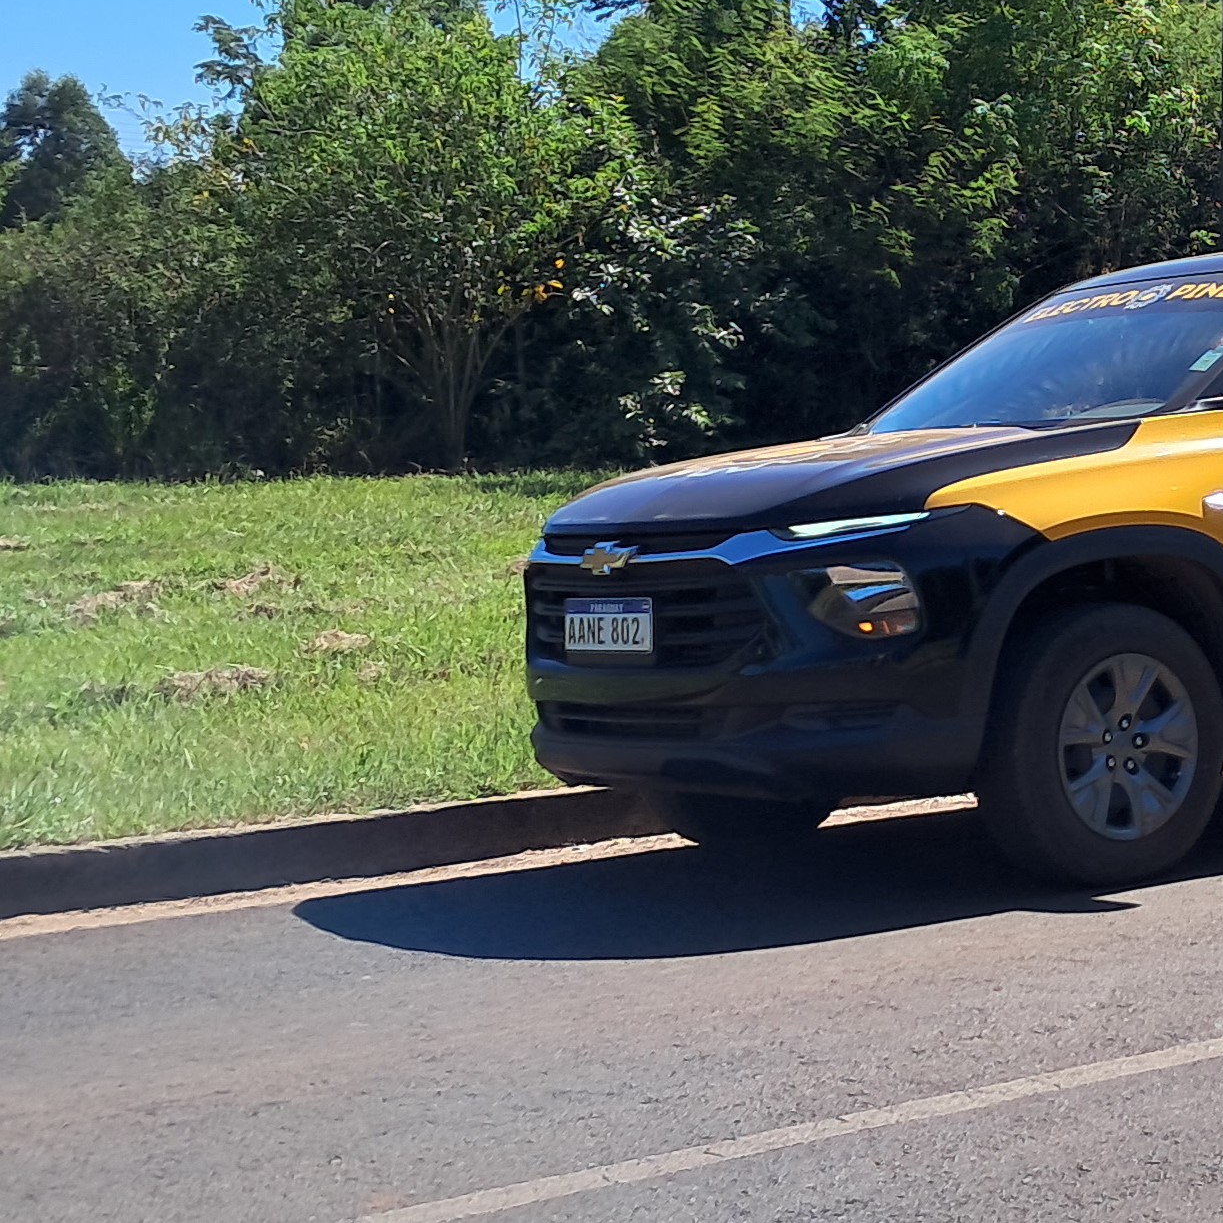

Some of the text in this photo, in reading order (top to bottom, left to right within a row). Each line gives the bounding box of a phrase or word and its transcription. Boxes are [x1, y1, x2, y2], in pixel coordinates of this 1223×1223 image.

[1024, 290, 1139, 323] ELECTRO
[568, 617, 640, 645] AANE 802
